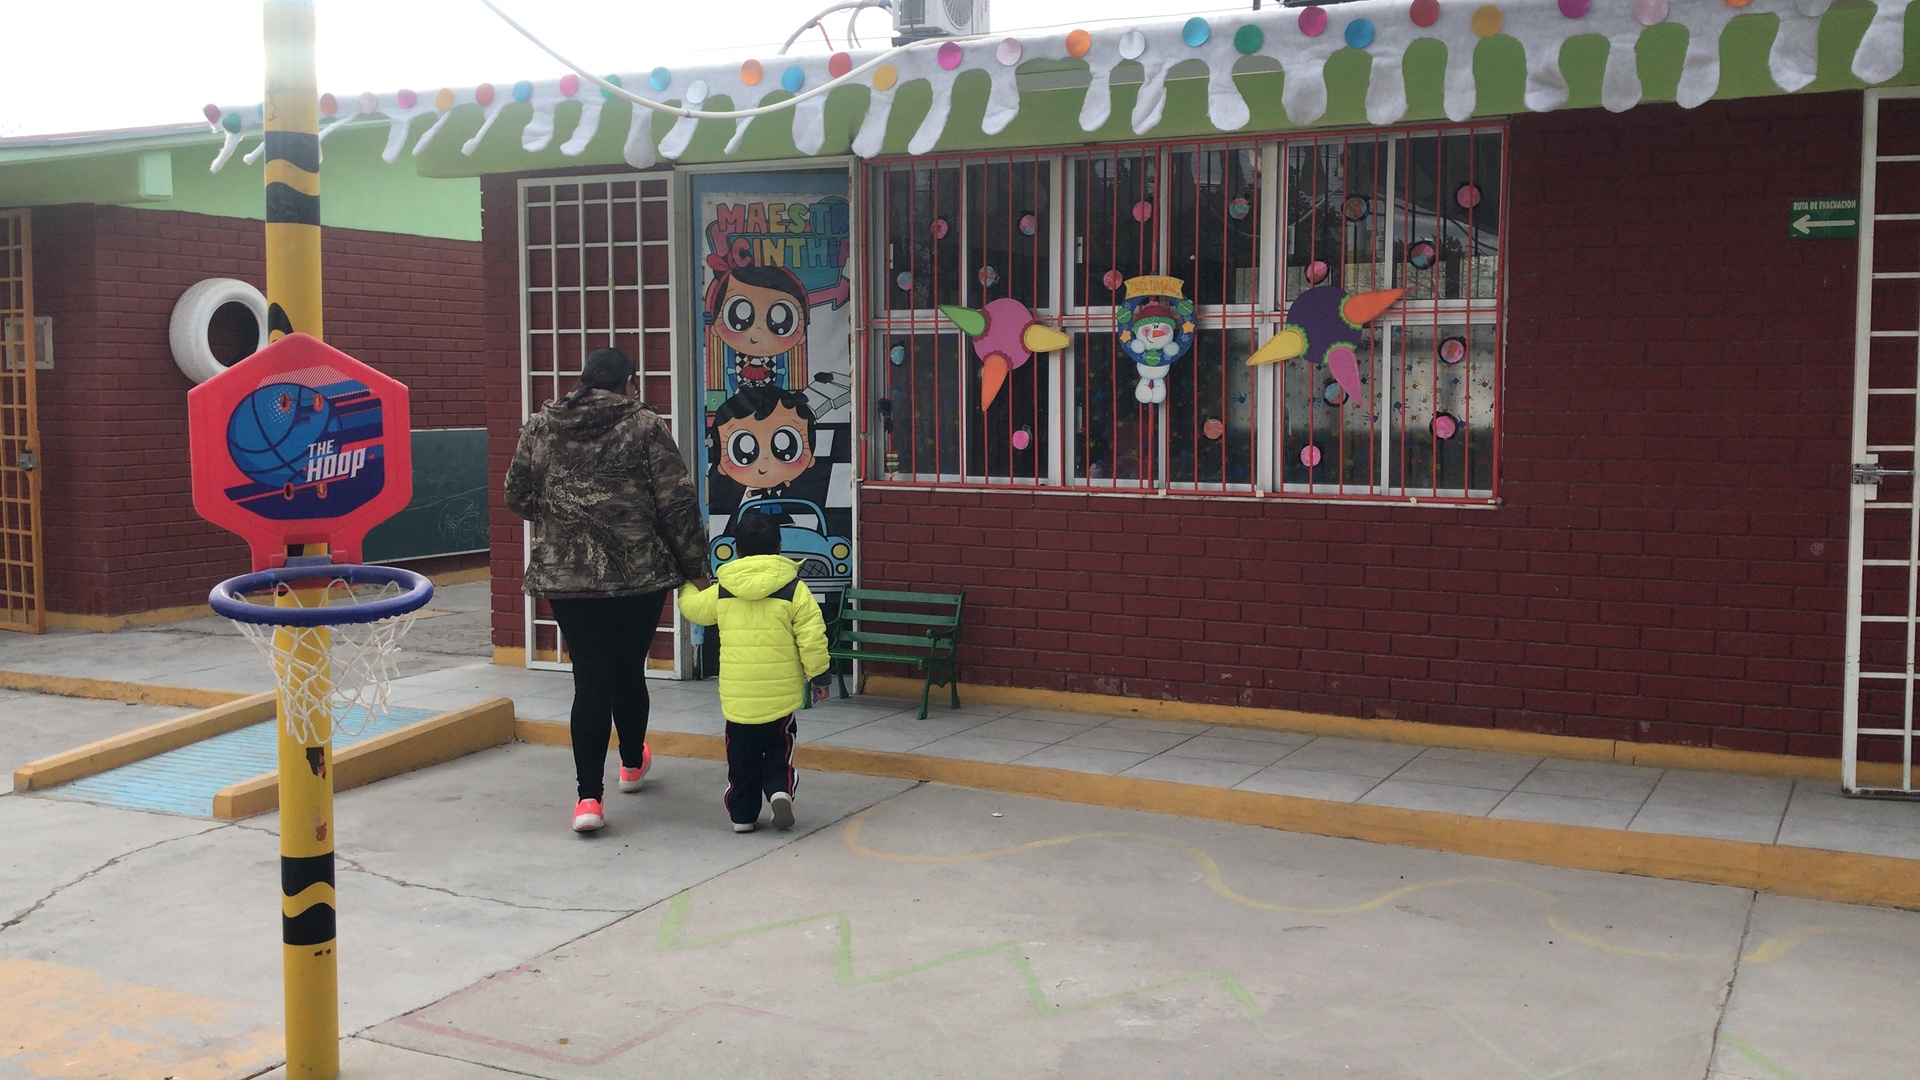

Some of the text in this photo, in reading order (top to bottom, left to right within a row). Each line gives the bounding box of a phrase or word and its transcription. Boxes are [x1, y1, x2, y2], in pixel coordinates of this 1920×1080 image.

[1793, 202, 1808, 211] RUTA
[1810, 202, 1818, 210] DE
[308, 439, 336, 458] THE
[306, 447, 367, 482] HOOP
